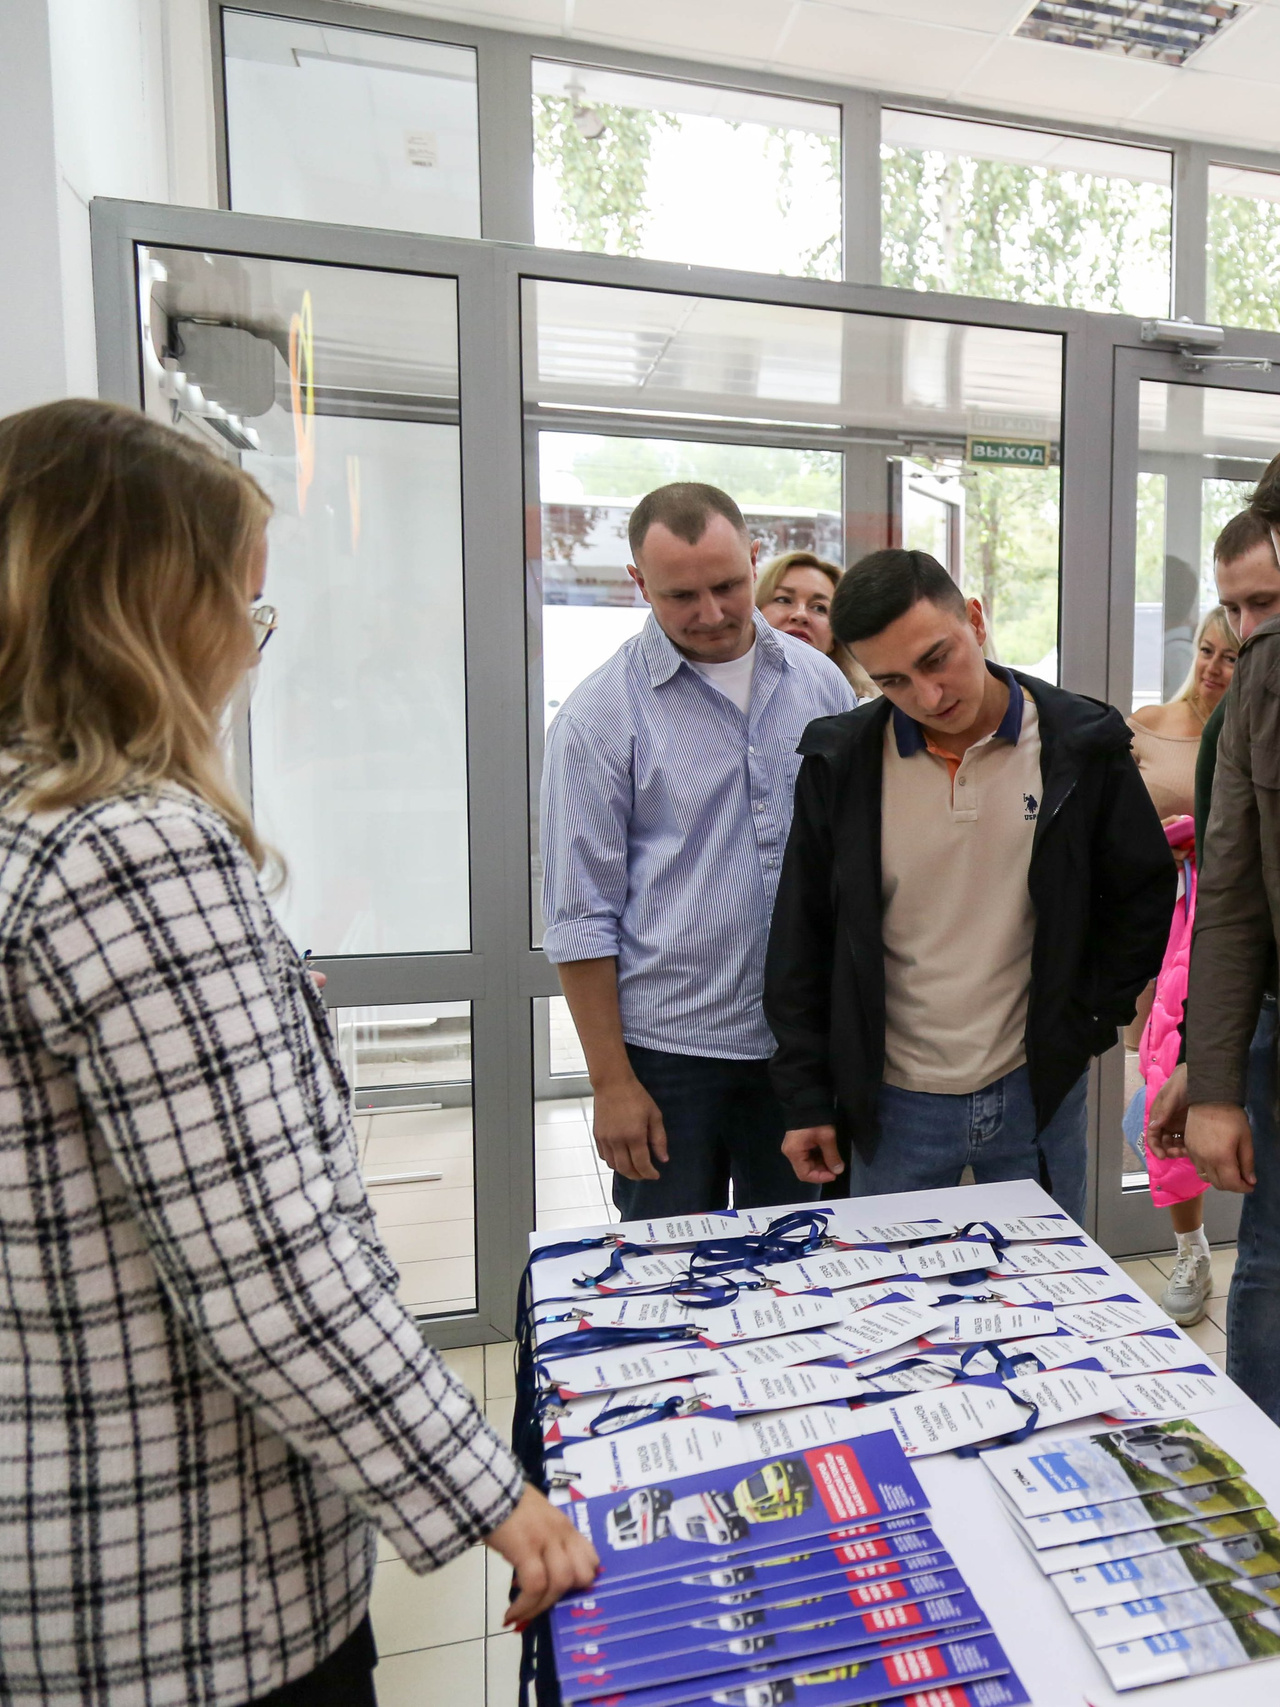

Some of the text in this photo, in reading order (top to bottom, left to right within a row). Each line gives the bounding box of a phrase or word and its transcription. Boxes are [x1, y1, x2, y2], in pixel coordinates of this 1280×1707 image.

[973, 444, 1044, 463] ВЫХОД
[912, 1403, 939, 1443] БАКЛАНОВ
[936, 1400, 959, 1433] СЕРГЕЕВИЧ
